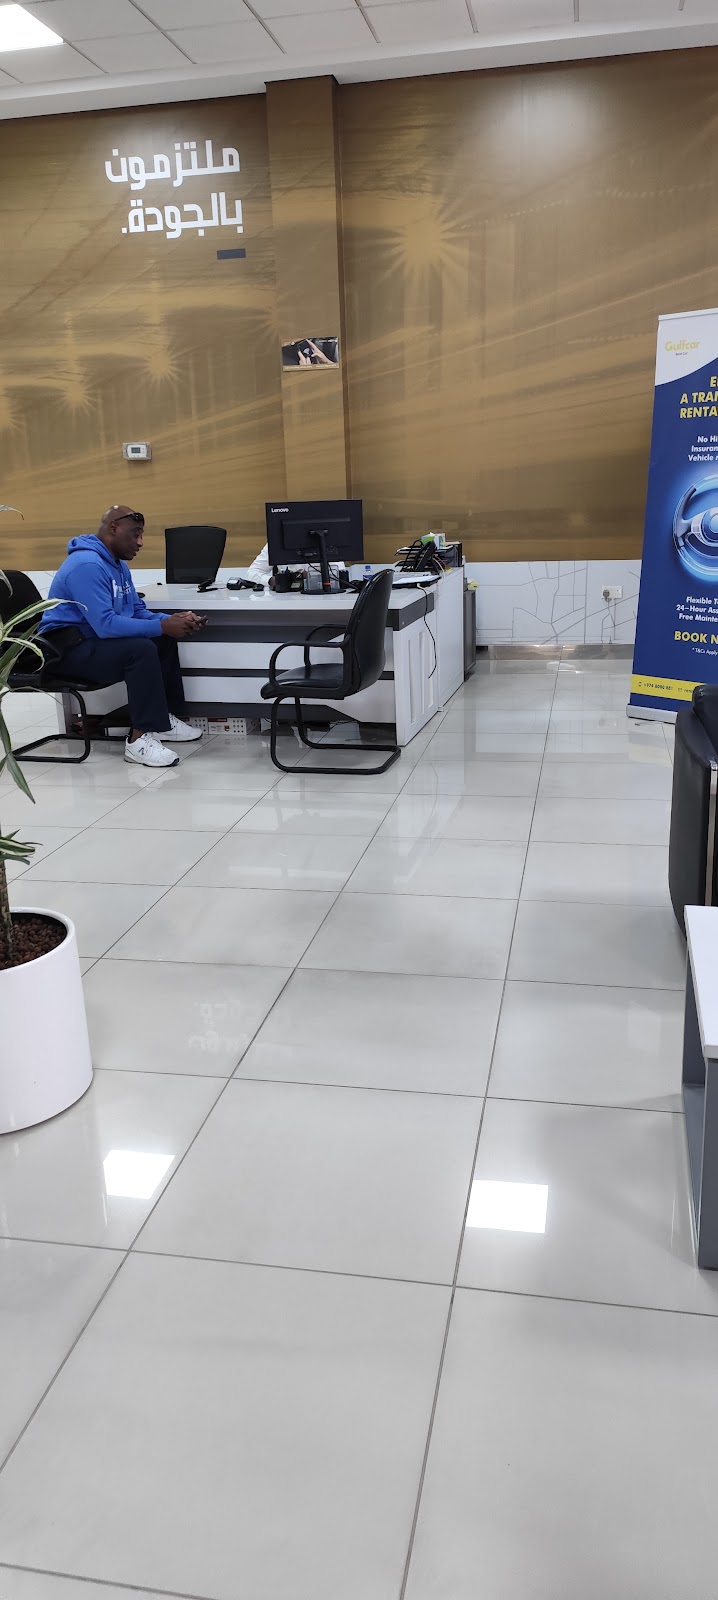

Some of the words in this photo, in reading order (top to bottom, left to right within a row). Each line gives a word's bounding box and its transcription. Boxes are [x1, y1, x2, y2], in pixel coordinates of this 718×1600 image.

[104, 140, 241, 191] ملتزمون
[121, 192, 244, 239] بالجودة.
[665, 339, 700, 351] Gulfcar
[680, 393, 688, 404] A
[697, 436, 708, 444] No
[688, 453, 714, 462] Vehicle
[686, 596, 712, 605] Flexible
[679, 612, 694, 620] Free
[674, 630, 708, 643] BOOK
